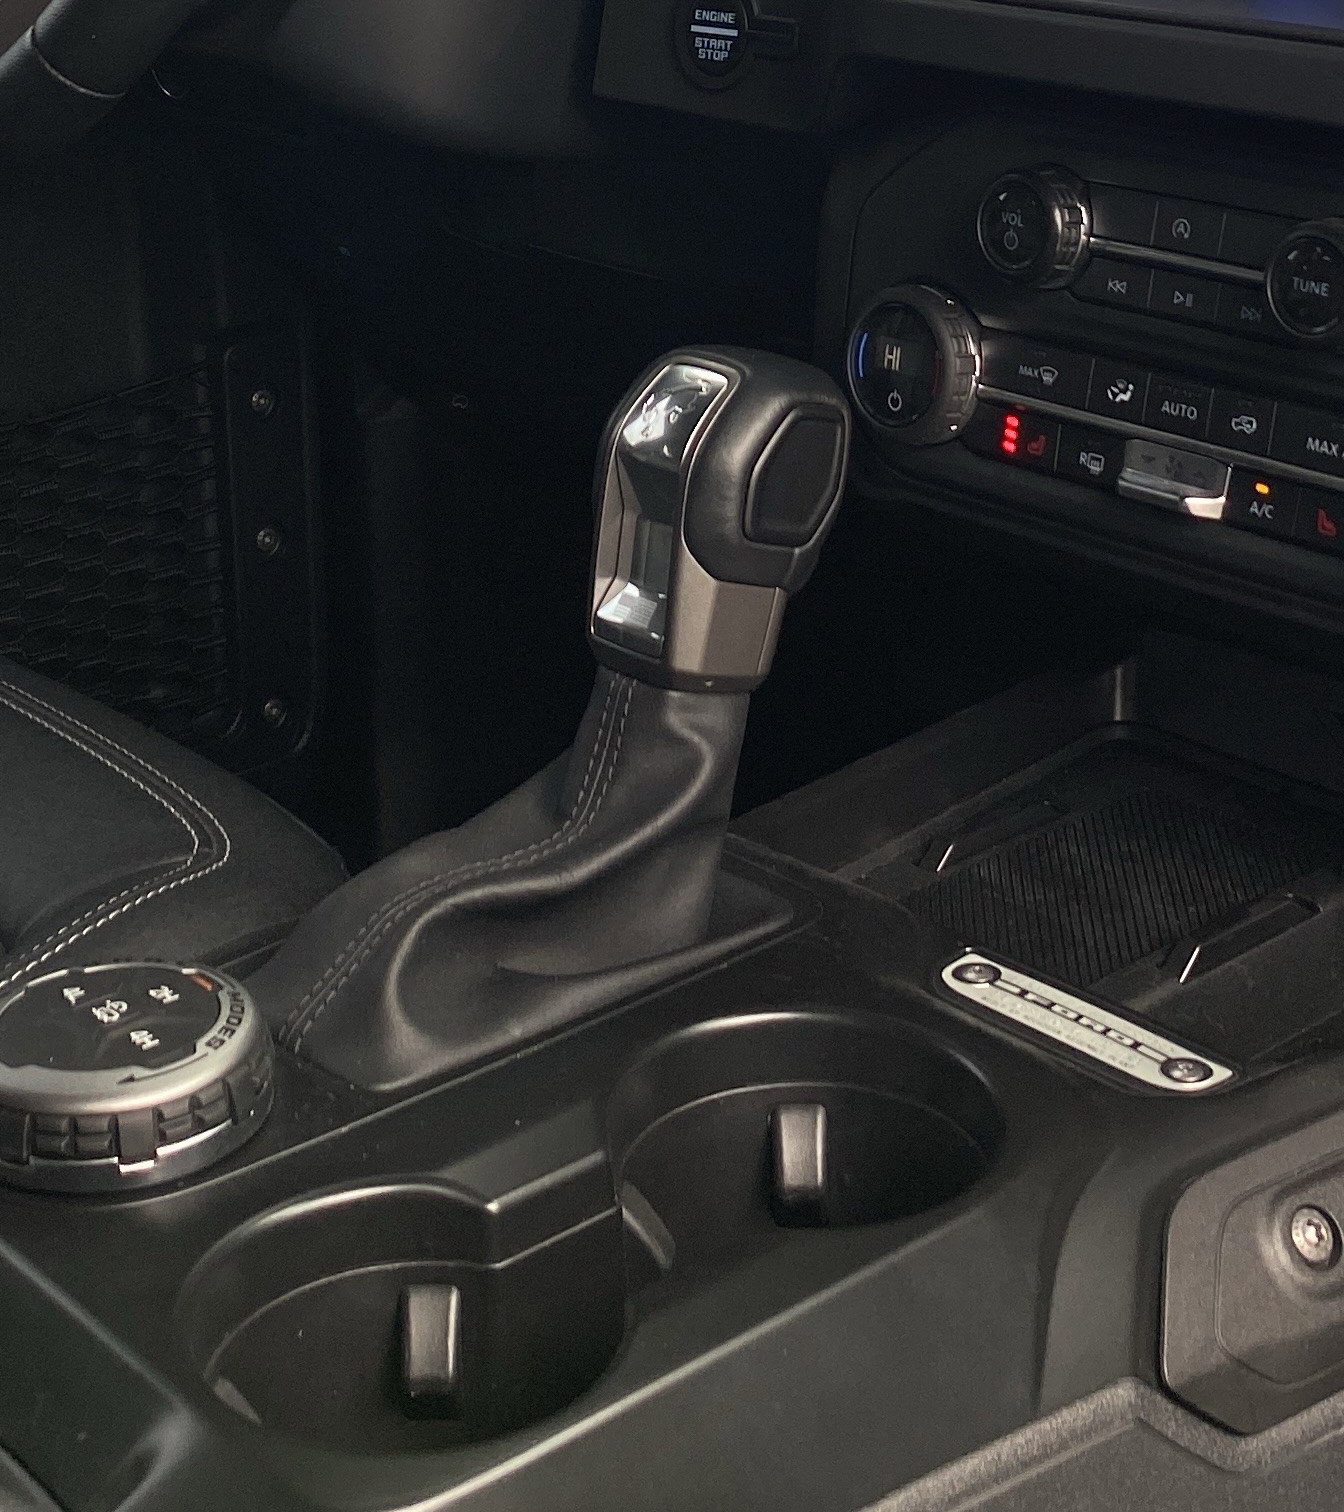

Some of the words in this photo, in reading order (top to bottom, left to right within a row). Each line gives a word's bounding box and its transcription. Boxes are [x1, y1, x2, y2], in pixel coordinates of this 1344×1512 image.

[694, 9, 736, 24] ENGINE
[694, 36, 733, 51] START
[698, 49, 729, 62] STOP
[1001, 210, 1024, 227] VOL
[1292, 276, 1330, 297] TUNE
[884, 343, 902, 372] HI
[1018, 364, 1040, 379] MAX
[1160, 400, 1198, 420] AUTO
[1306, 437, 1339, 458] MAX
[1248, 500, 1275, 520] A/C
